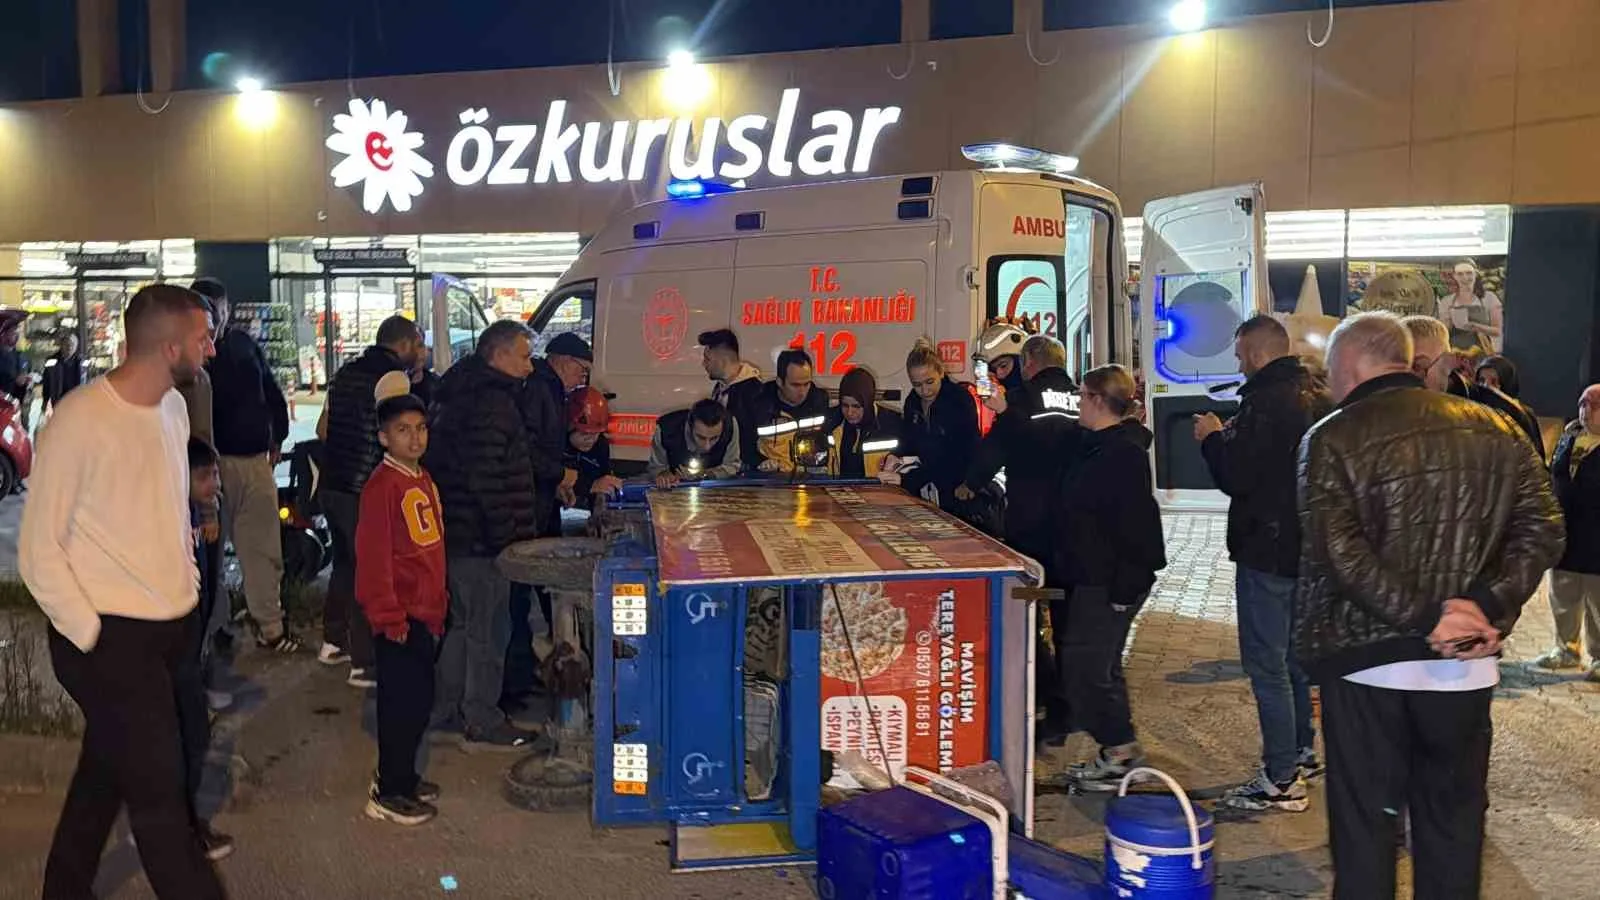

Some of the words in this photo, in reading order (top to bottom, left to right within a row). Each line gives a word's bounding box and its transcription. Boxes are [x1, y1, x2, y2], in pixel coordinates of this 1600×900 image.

[446, 87, 901, 189] özkuruşlar
[810, 265, 841, 293] T.C.
[742, 296, 801, 326] SAĞLIK
[812, 289, 916, 325] BAKANLIĞI
[940, 343, 961, 361] 112
[401, 487, 441, 546] G
[941, 589, 957, 686] TEREYAĞLI
[916, 646, 931, 677] 0537
[957, 642, 977, 723] MAVİŞİM
[887, 710, 903, 761] KIYMALI
[915, 721, 930, 736] 81
